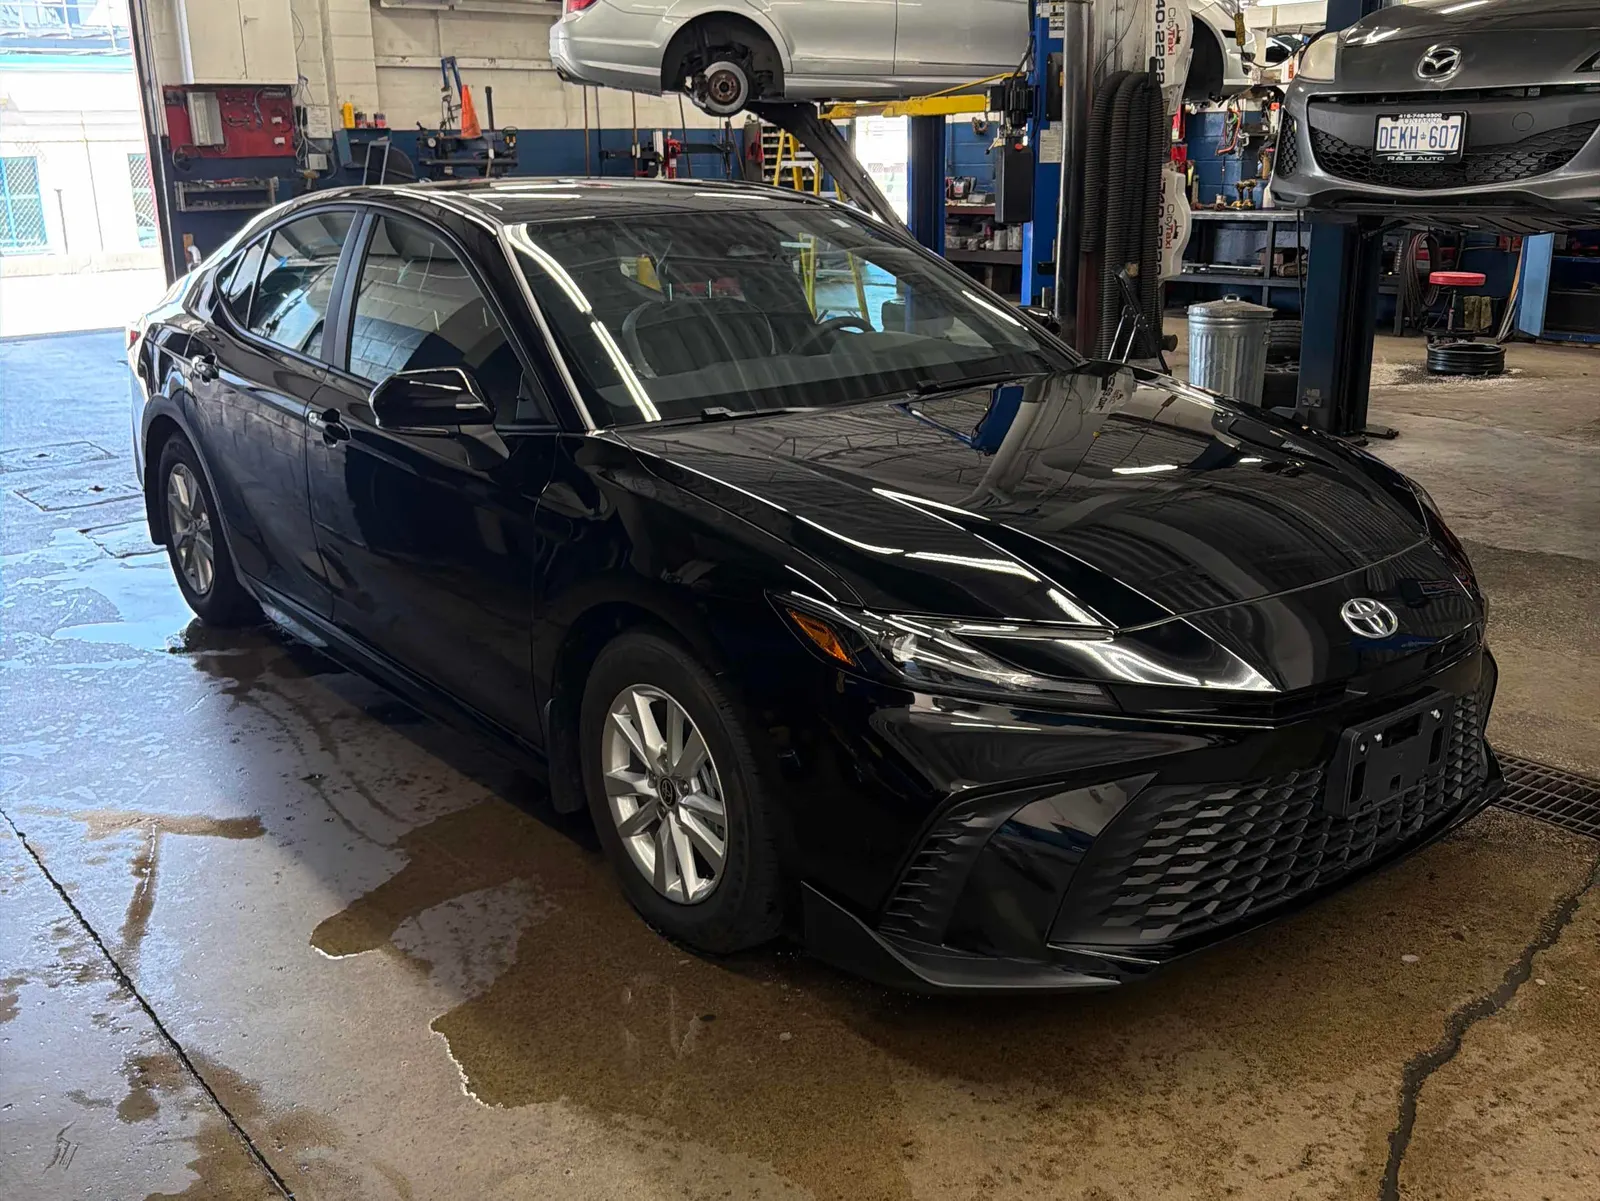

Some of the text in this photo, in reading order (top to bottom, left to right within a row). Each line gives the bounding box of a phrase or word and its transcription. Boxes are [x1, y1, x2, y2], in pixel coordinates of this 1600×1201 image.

[1166, 7, 1176, 56] CityTaxi
[1379, 125, 1459, 149] DEKH 607
[1165, 203, 1175, 250] CityTaxi
